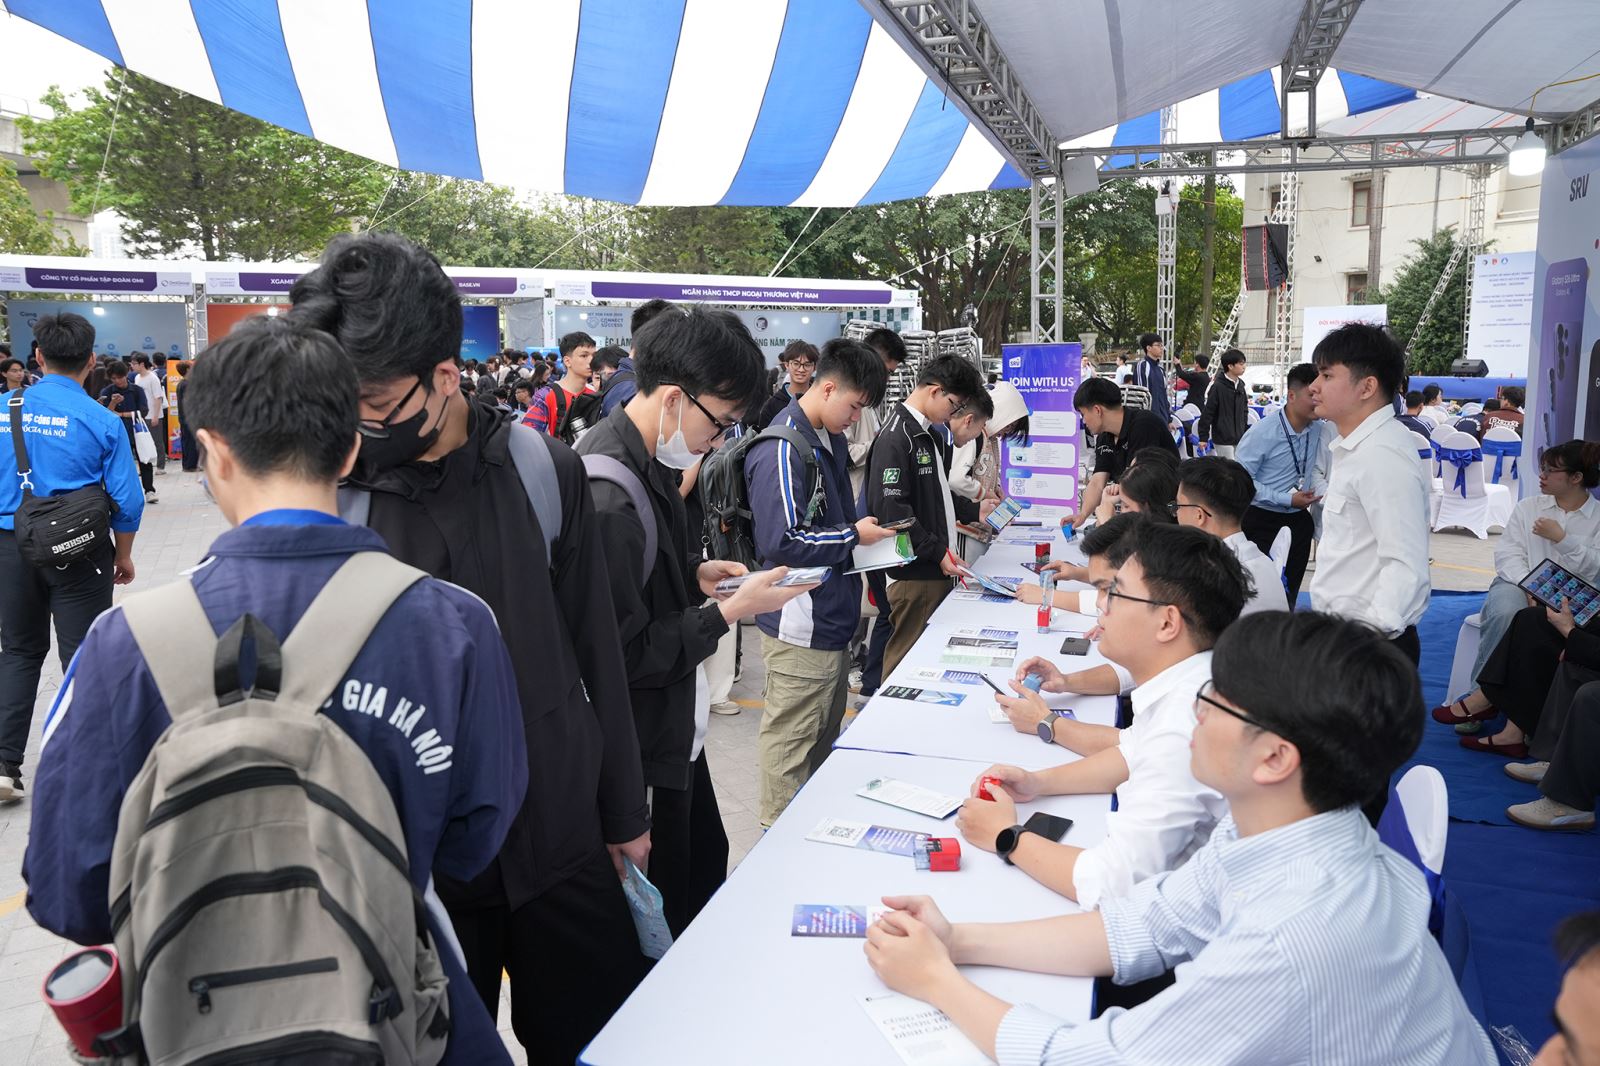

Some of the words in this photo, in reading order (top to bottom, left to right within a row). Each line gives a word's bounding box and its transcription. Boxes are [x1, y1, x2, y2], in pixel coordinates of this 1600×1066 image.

[1569, 173, 1590, 202] SRV
[681, 288, 701, 296] NGÂN
[702, 288, 721, 296] HÀNG
[741, 290, 762, 299] NGOẠI
[1032, 376, 1057, 387] WITH
[1060, 376, 1075, 387] US
[51, 530, 96, 554] FEISHENG
[342, 679, 388, 718] GIA
[388, 696, 426, 738] HÀ
[411, 728, 453, 775] NỘI
